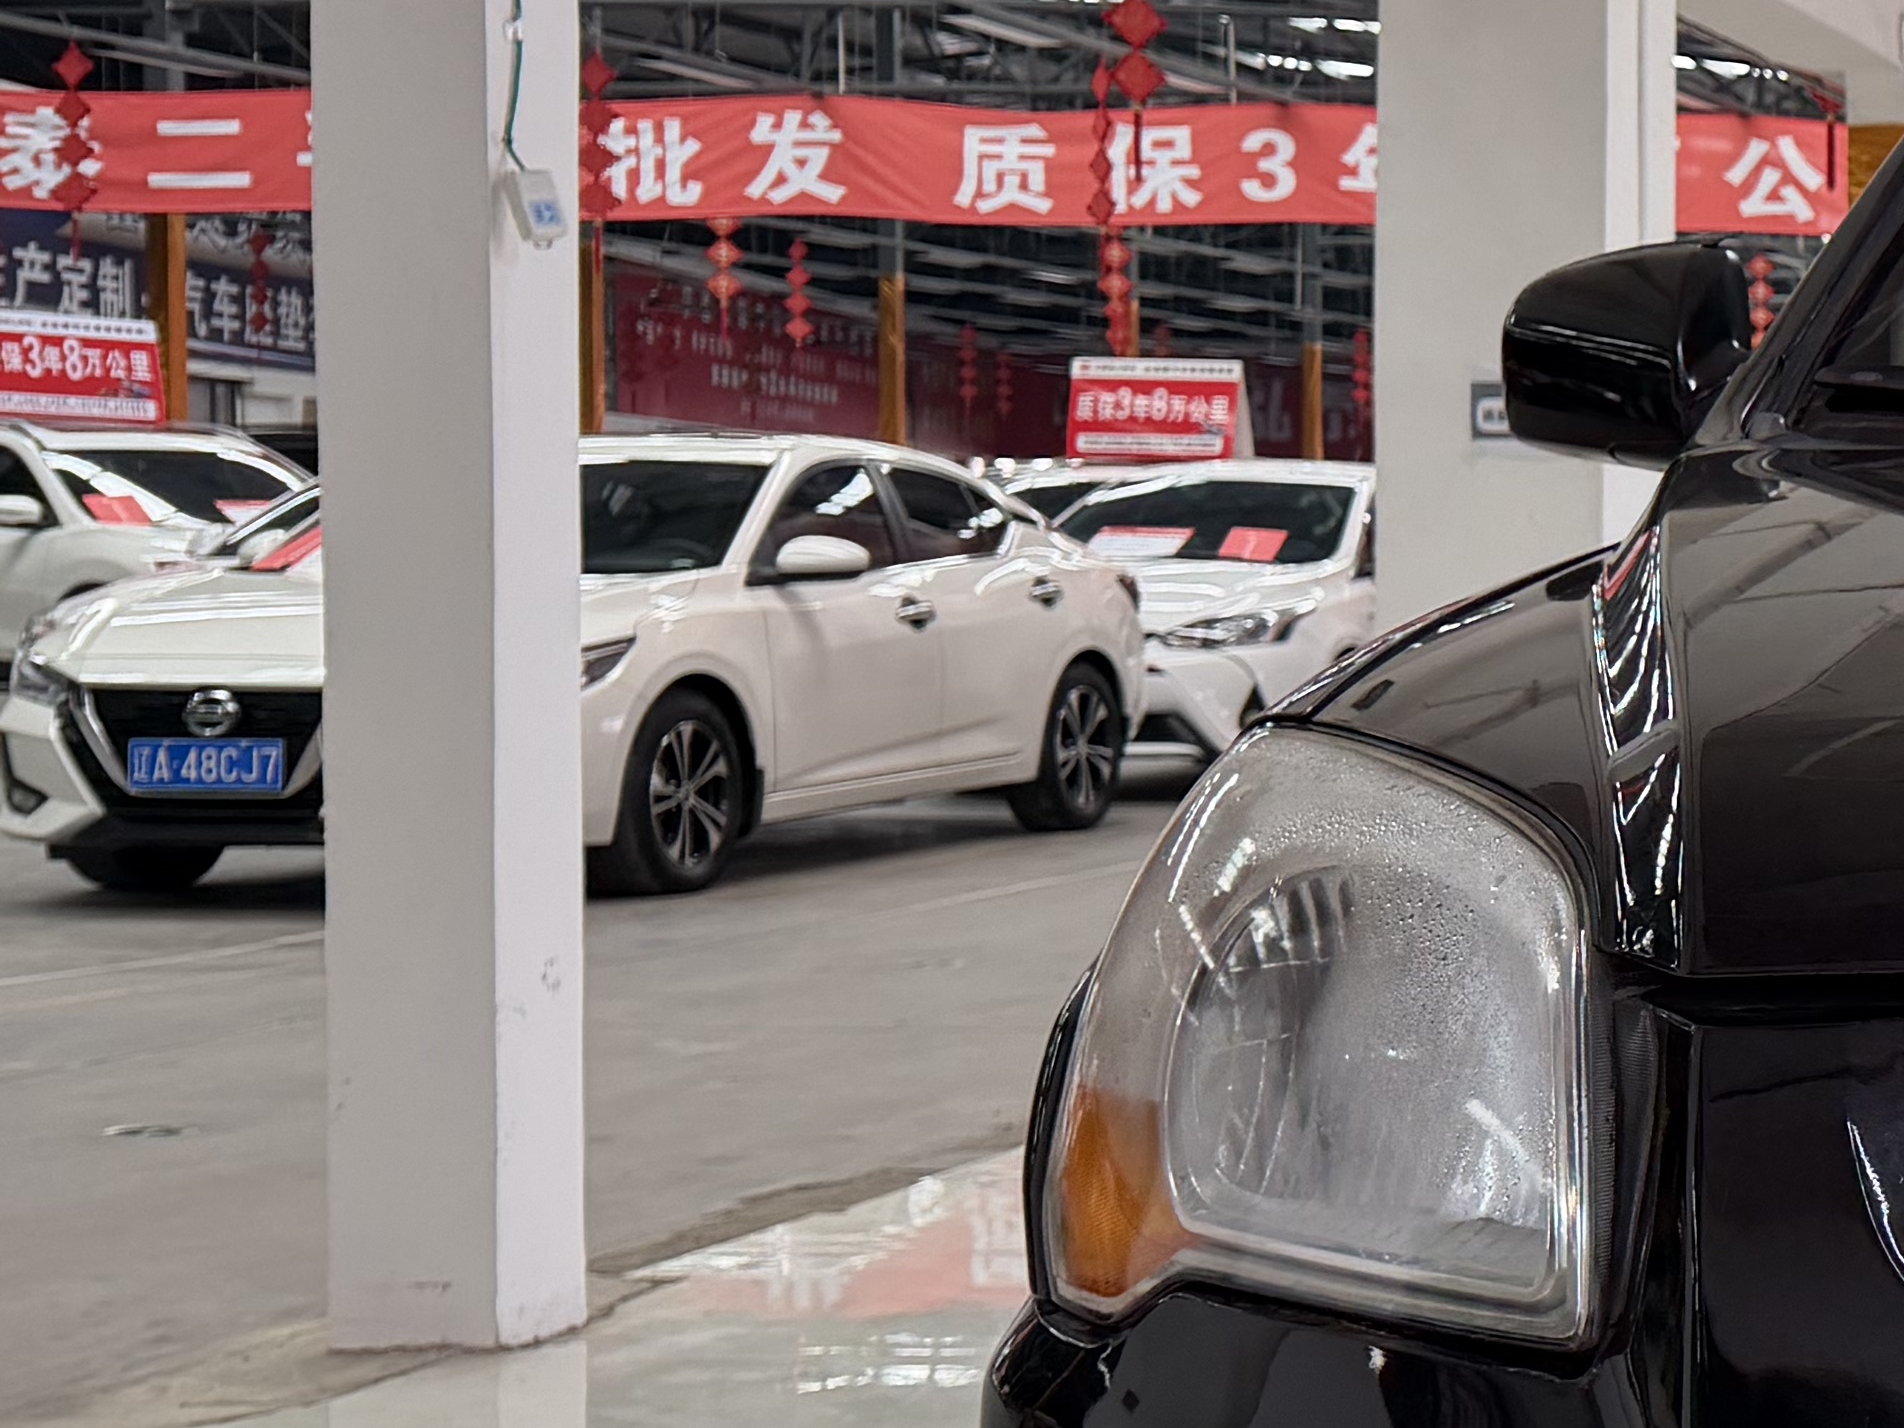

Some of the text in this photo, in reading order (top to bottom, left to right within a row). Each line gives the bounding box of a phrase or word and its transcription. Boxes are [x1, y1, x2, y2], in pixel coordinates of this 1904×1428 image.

[1075, 386, 1231, 426] 质保3年8万公里
